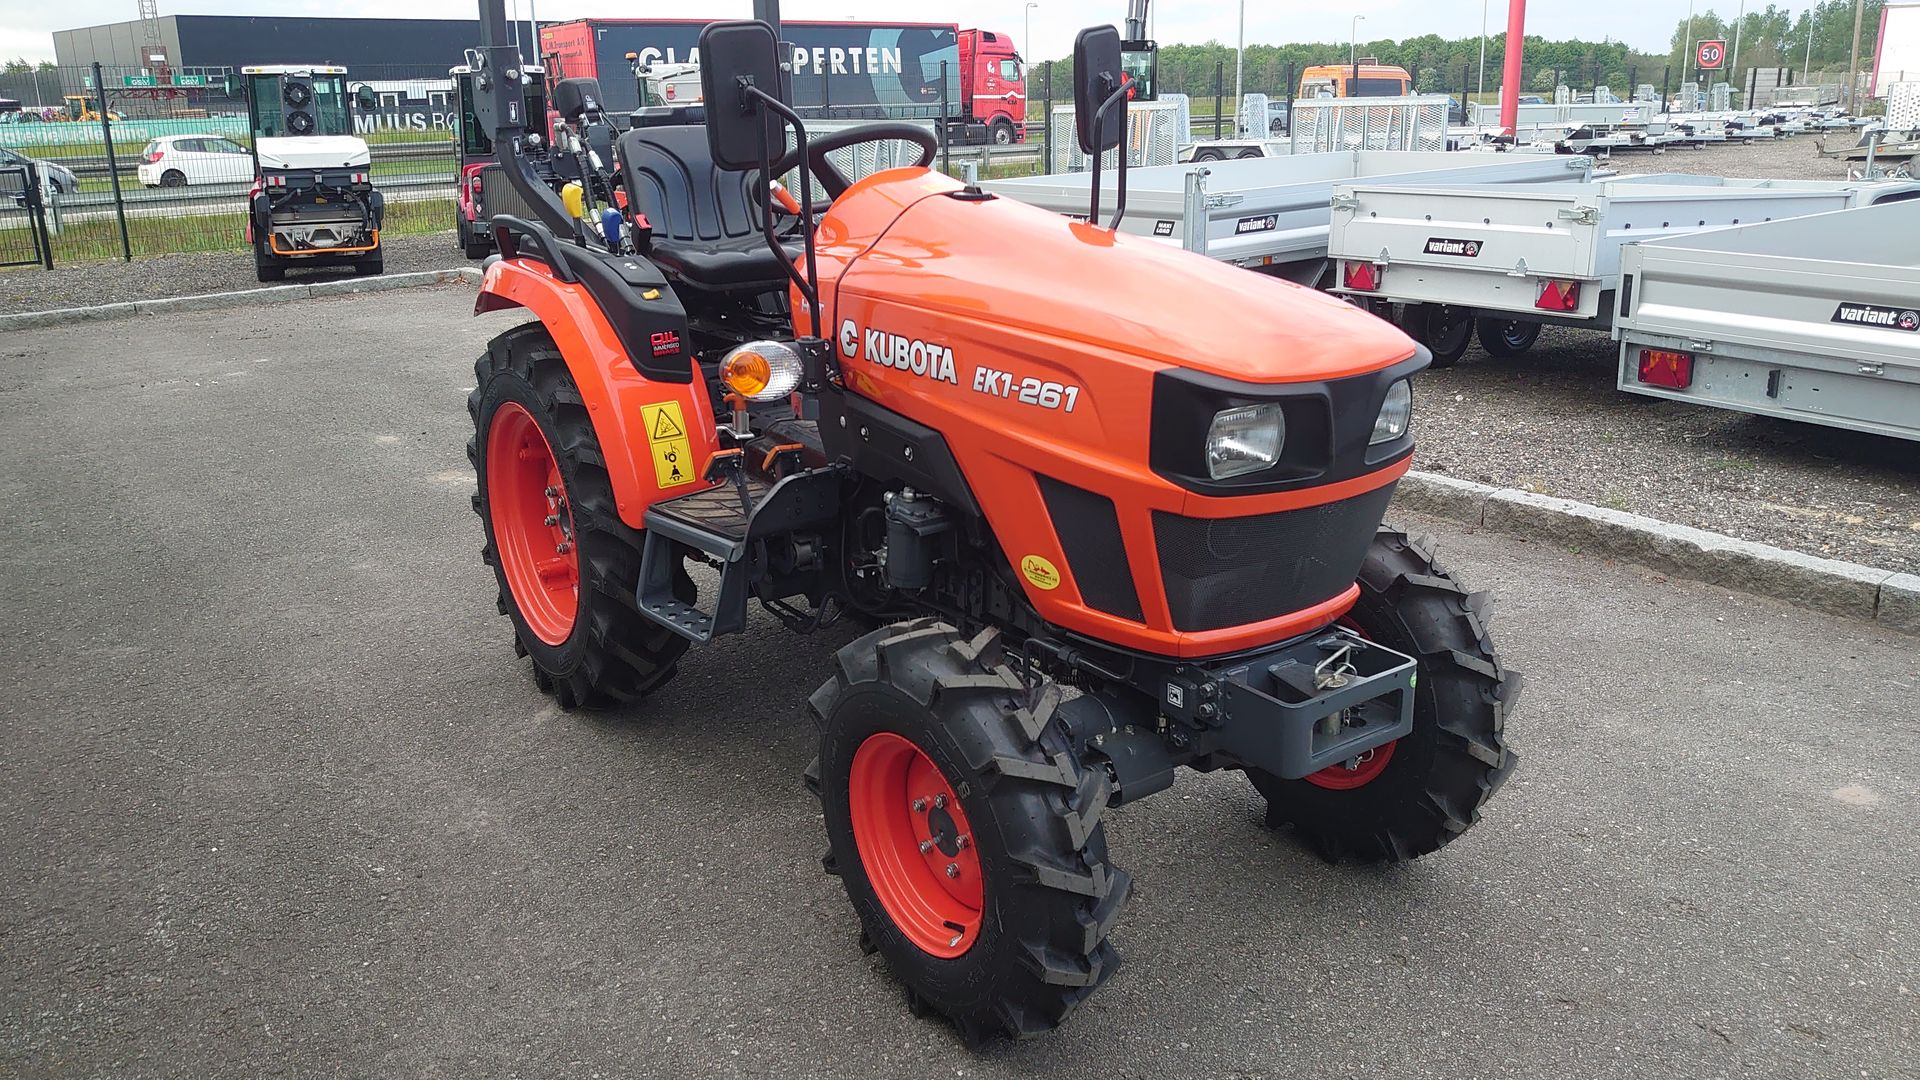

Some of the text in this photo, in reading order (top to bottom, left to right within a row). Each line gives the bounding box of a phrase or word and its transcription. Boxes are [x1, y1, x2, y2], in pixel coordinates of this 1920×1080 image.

[1701, 48, 1719, 60] 50
[353, 112, 427, 134] MUUS
[1239, 218, 1266, 232] variant
[1428, 240, 1465, 254] variant
[1840, 306, 1898, 325] variant
[651, 331, 679, 346] OIL
[864, 327, 958, 385] KUBOTA
[972, 365, 1080, 414] EK1-261
